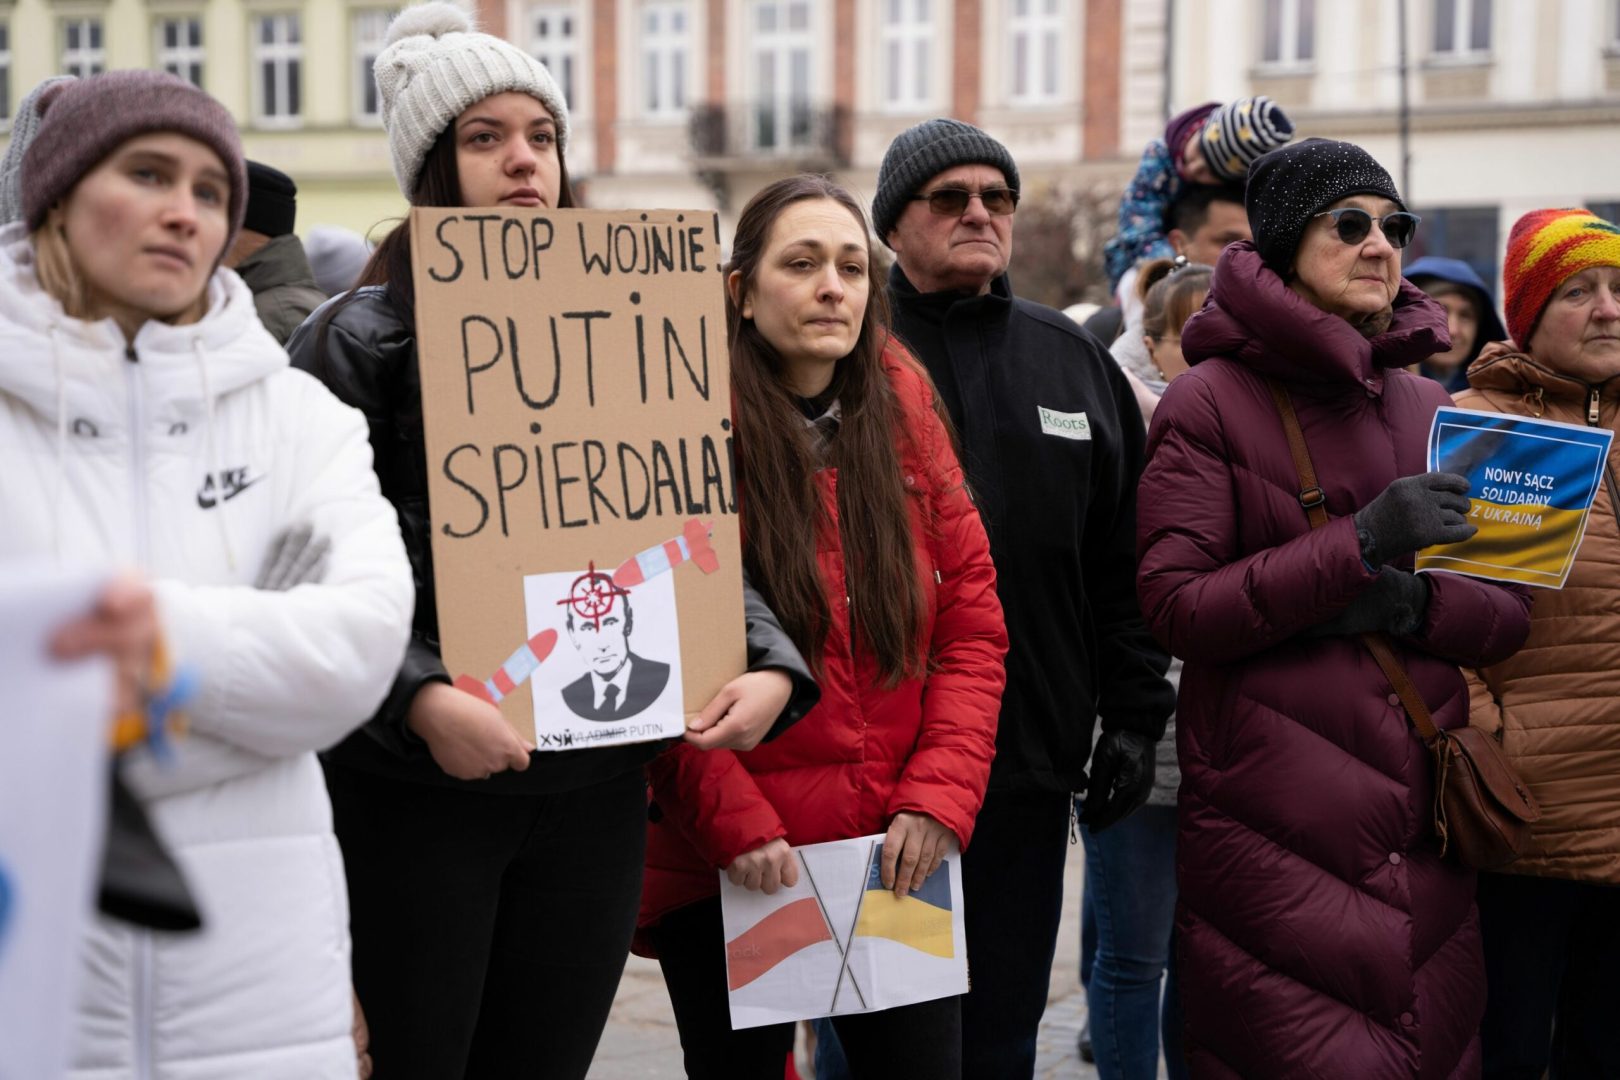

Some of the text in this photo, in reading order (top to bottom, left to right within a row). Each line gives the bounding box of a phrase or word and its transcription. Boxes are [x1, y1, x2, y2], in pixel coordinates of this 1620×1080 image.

[428, 215, 554, 283] STOP
[461, 291, 710, 416] PUTIN
[1041, 409, 1087, 431] Roots
[1484, 466, 1555, 492] NOWY SĄCZ
[1480, 486, 1552, 508] SOLIDARNY
[1470, 504, 1543, 531] Z UKRAINĄ
[630, 723, 663, 737] PUTIN
